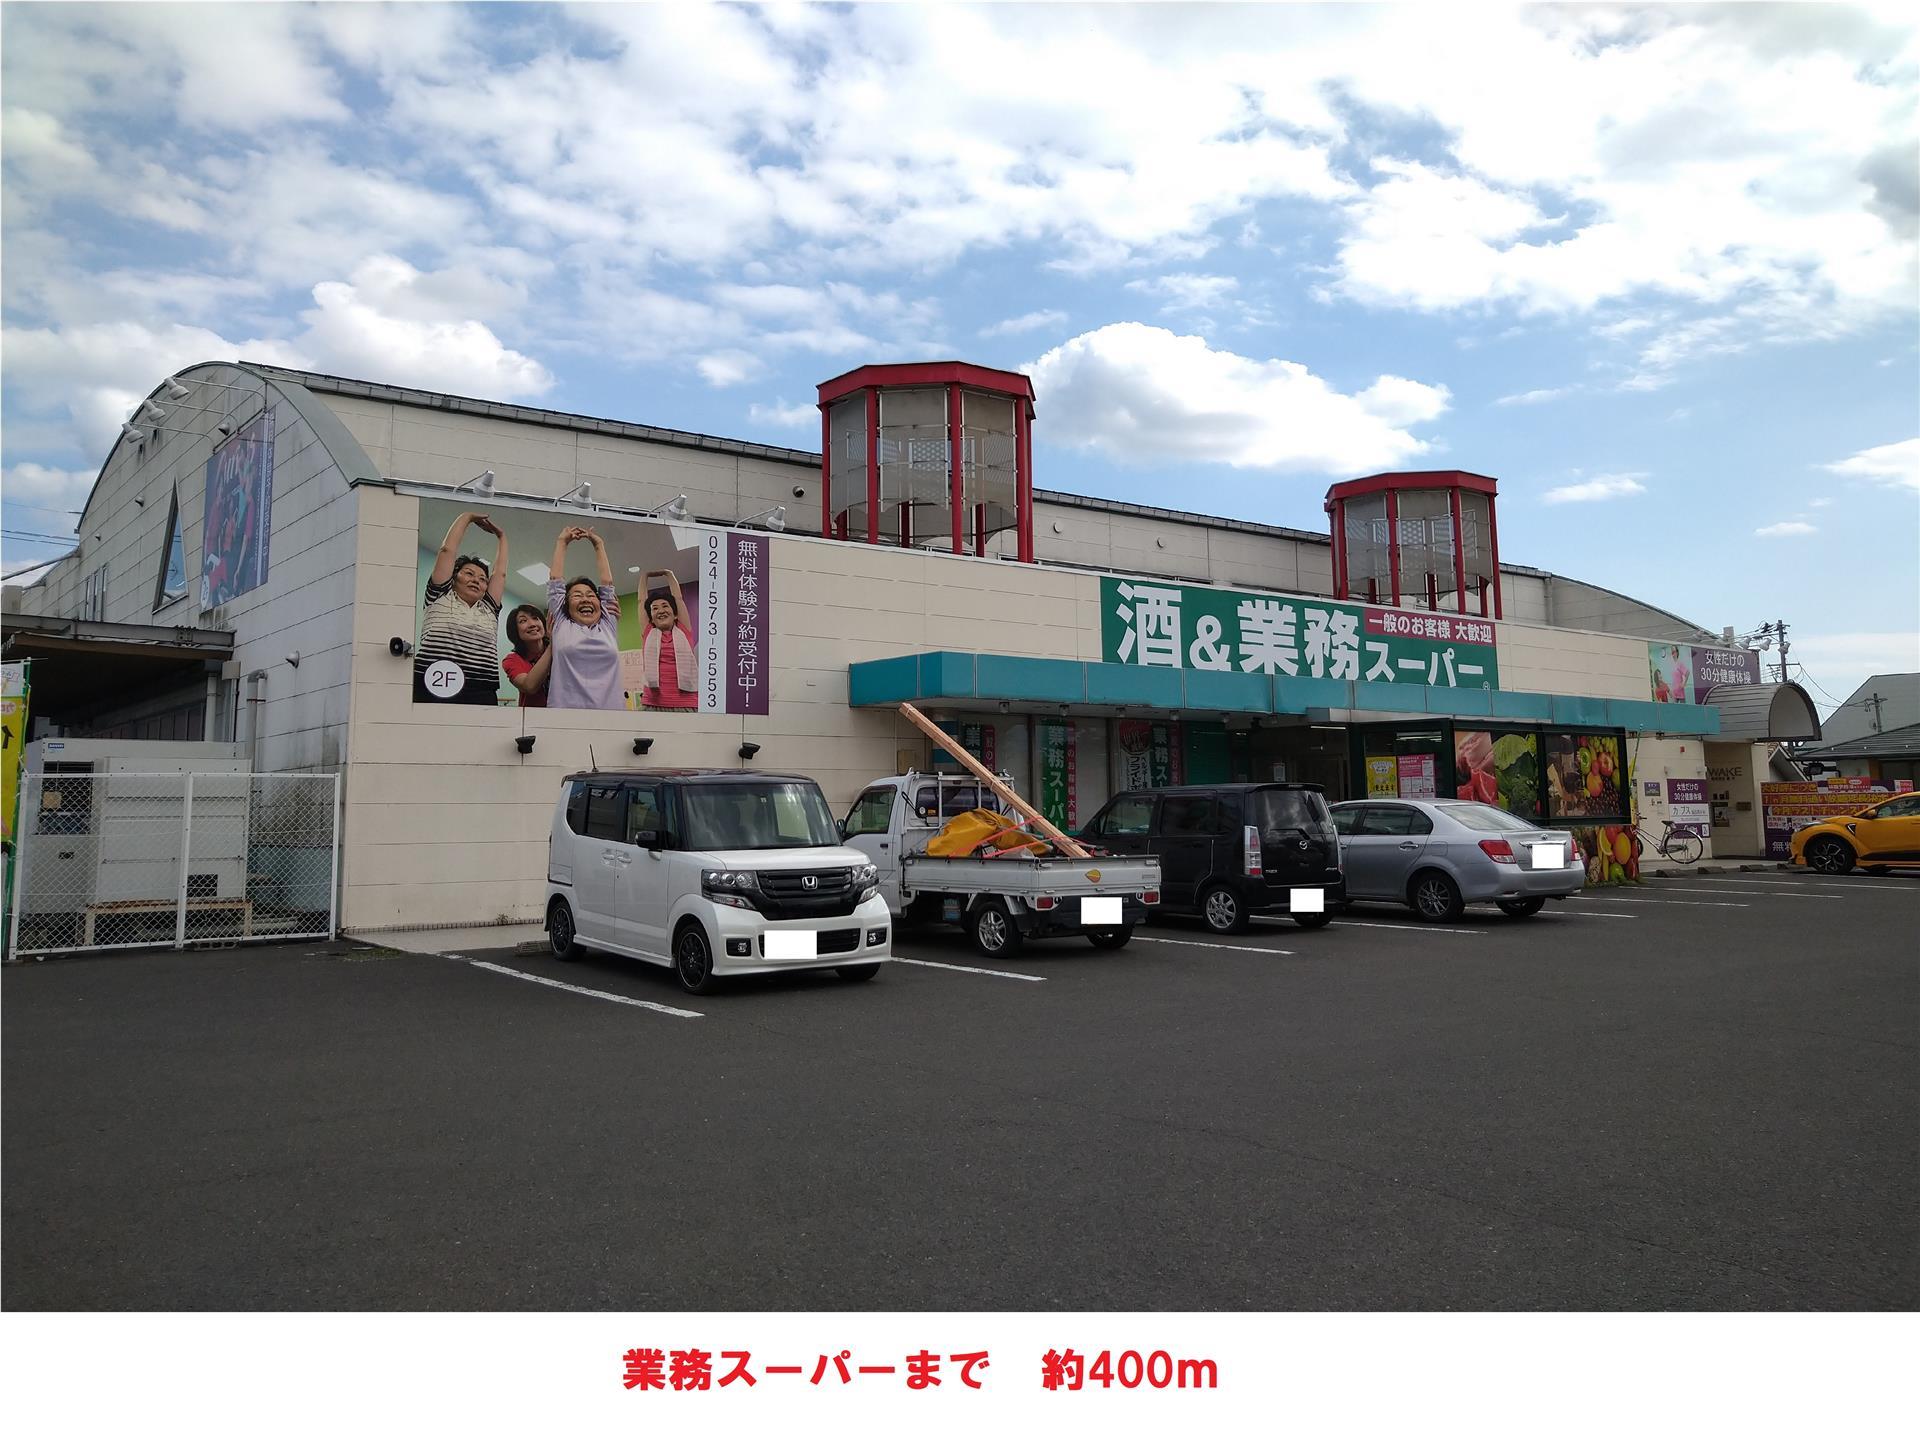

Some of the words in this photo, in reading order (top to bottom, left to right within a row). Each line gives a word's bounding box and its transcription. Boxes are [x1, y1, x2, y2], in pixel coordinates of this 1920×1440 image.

[706, 534, 719, 709] 024-573-5553
[1368, 613, 1451, 639] 一般のお客様
[1455, 621, 1493, 644] 大歓迎
[1705, 650, 1745, 667] 女性だけの
[431, 670, 457, 688] 2F
[1700, 667, 1751, 684] 30分健康体操
